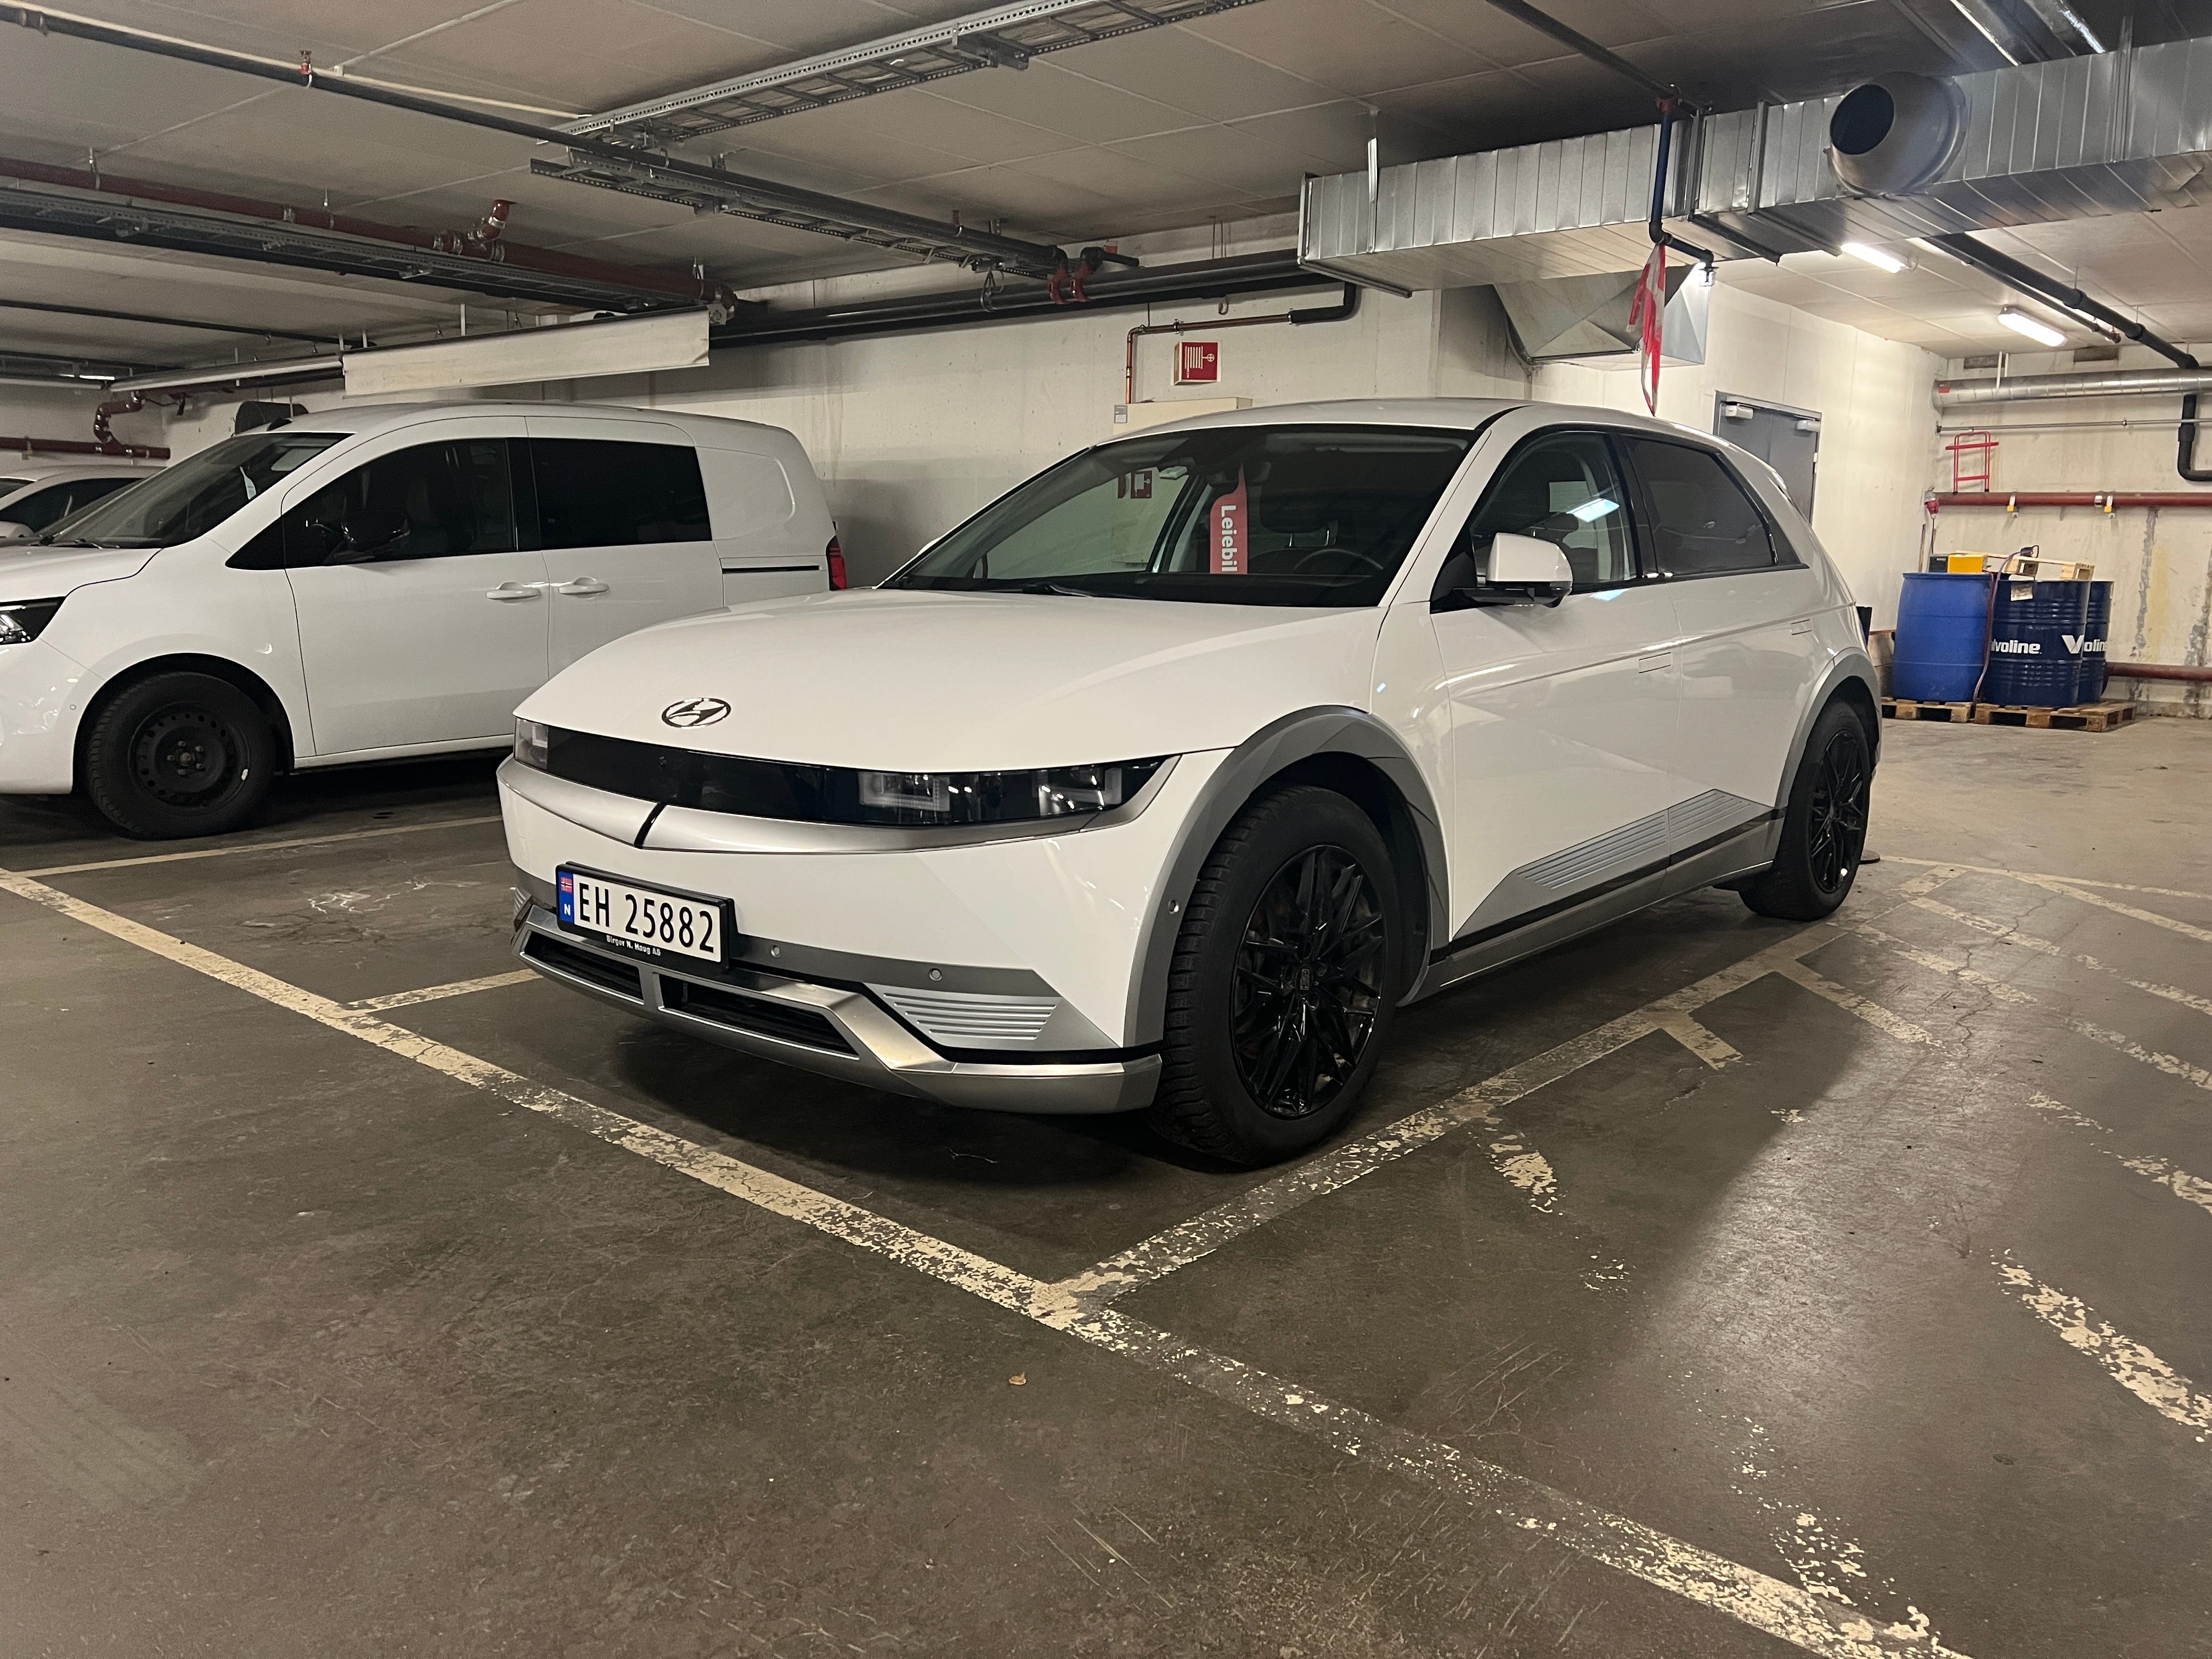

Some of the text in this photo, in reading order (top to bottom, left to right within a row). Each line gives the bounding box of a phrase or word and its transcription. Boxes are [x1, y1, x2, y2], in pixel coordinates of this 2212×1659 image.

[1221, 505, 1238, 572] Leiebil
[564, 904, 571, 916] N
[579, 882, 714, 953] EH 25882
[634, 943, 651, 955] Haug
